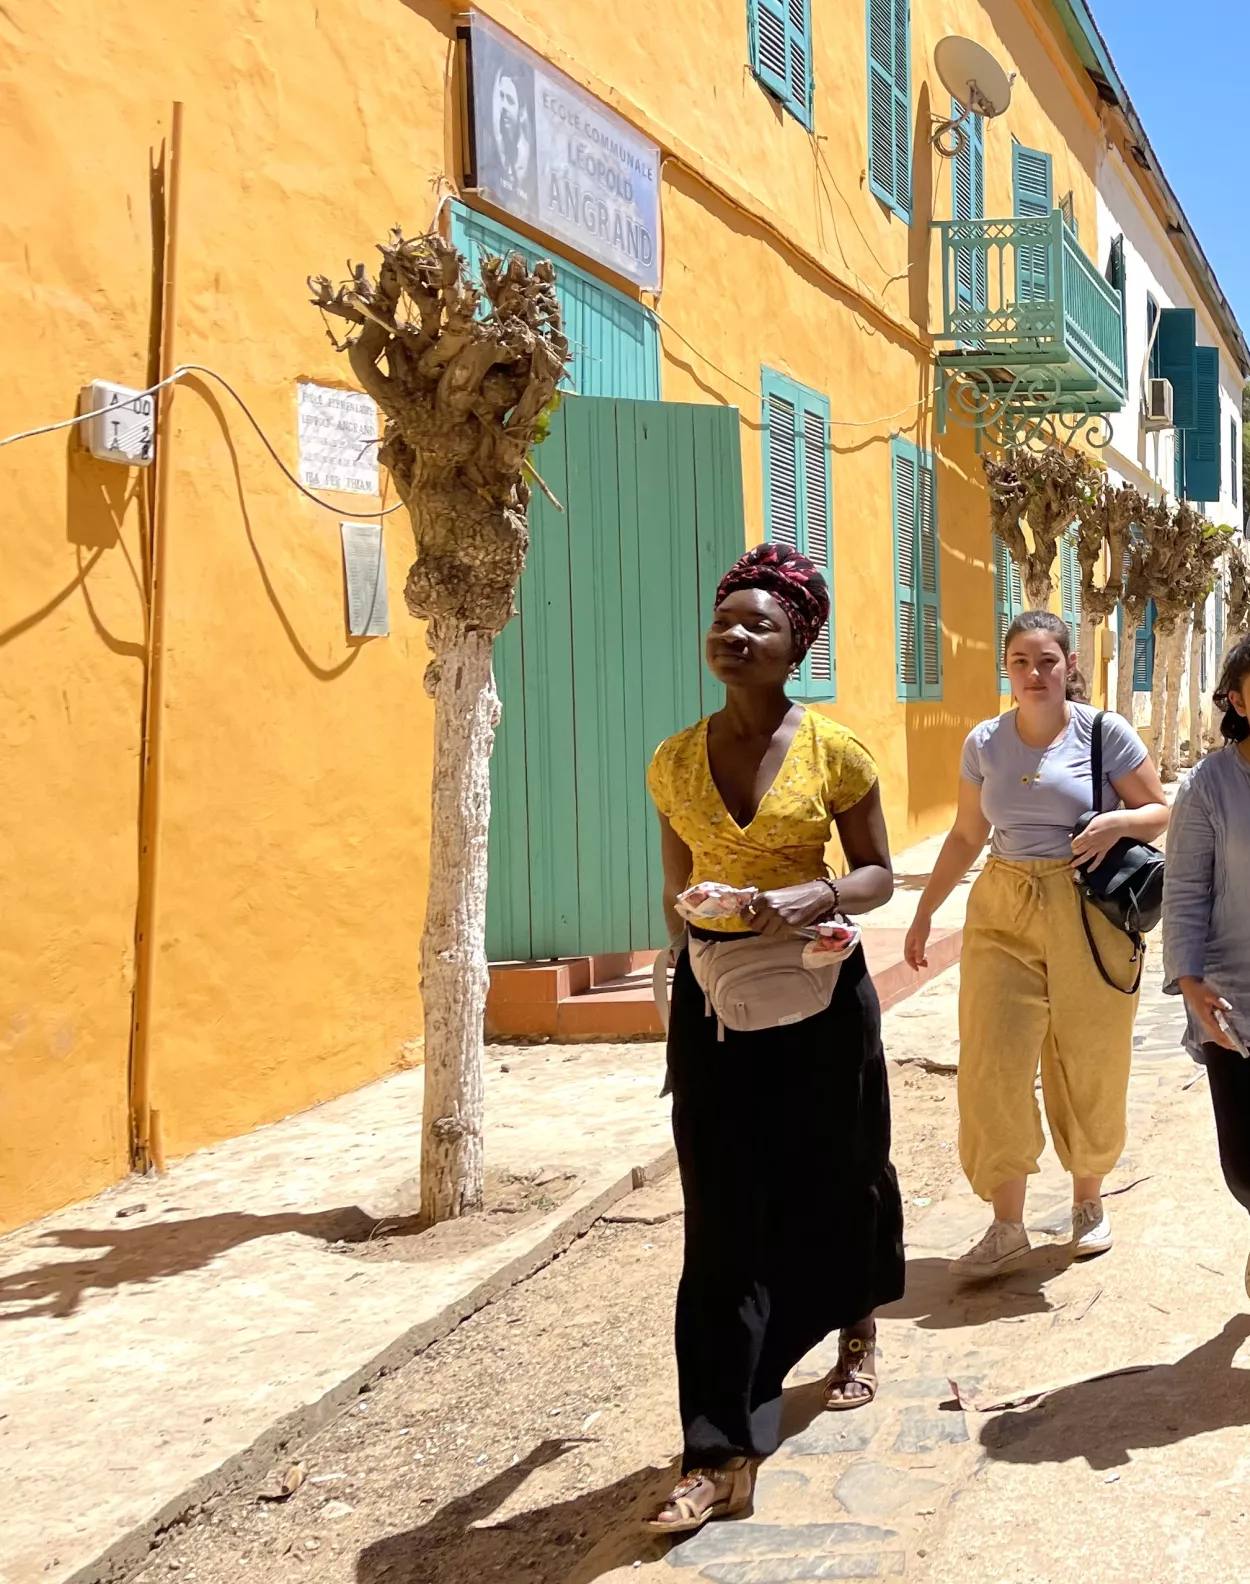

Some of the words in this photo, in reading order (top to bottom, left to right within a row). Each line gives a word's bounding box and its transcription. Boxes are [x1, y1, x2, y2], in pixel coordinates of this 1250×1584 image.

[584, 122, 653, 182] COMMUNALE
[548, 170, 652, 267] ANGRAND
[336, 421, 375, 436] ANGRAND
